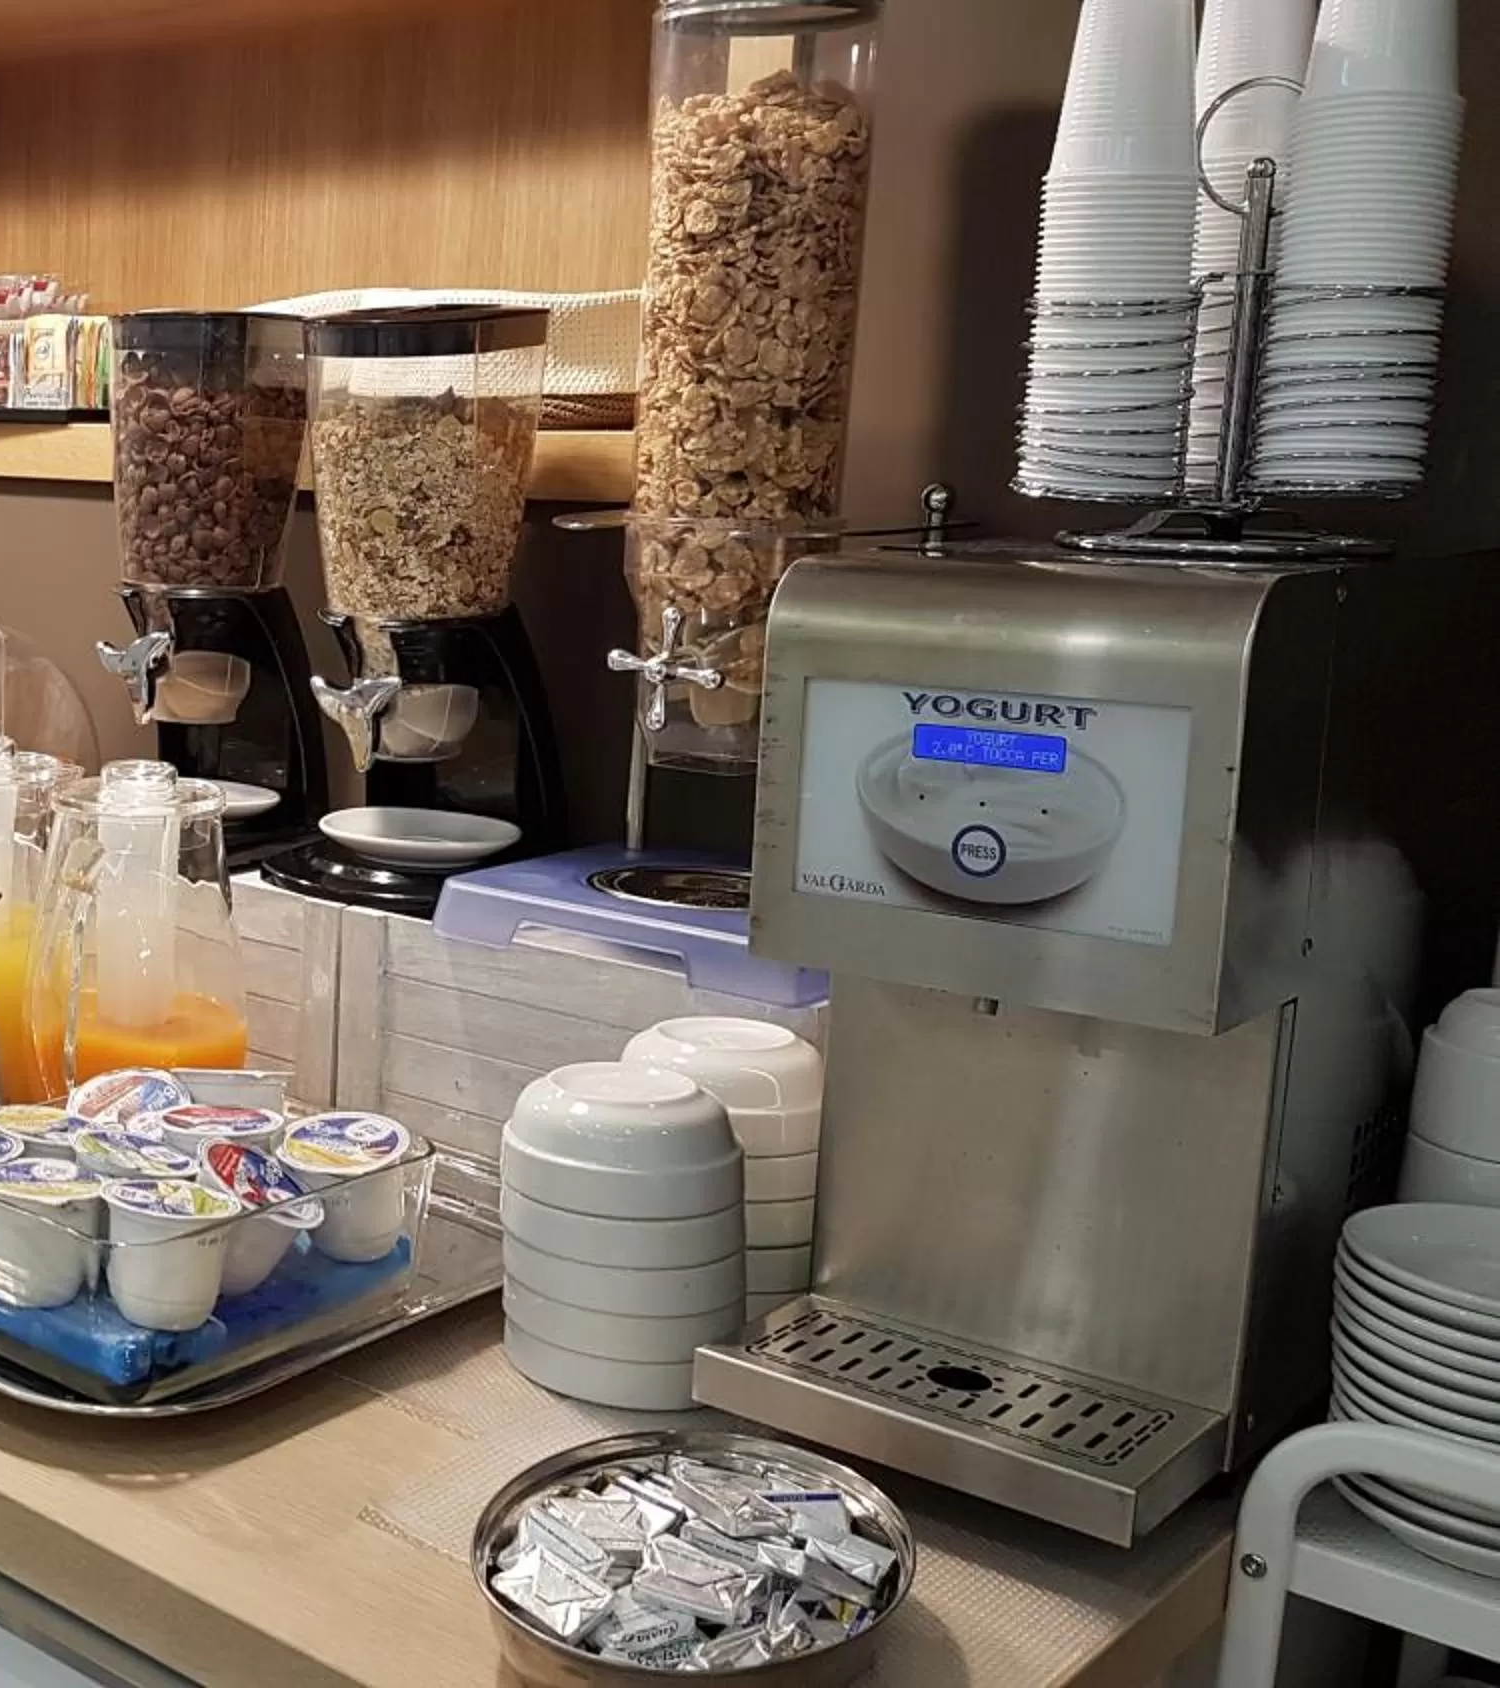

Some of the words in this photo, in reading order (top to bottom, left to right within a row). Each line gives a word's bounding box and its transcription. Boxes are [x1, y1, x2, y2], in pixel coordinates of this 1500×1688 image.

[904, 691, 1097, 730] YOGURT
[966, 731, 1017, 748] YOGURT
[960, 842, 997, 860] PRESS
